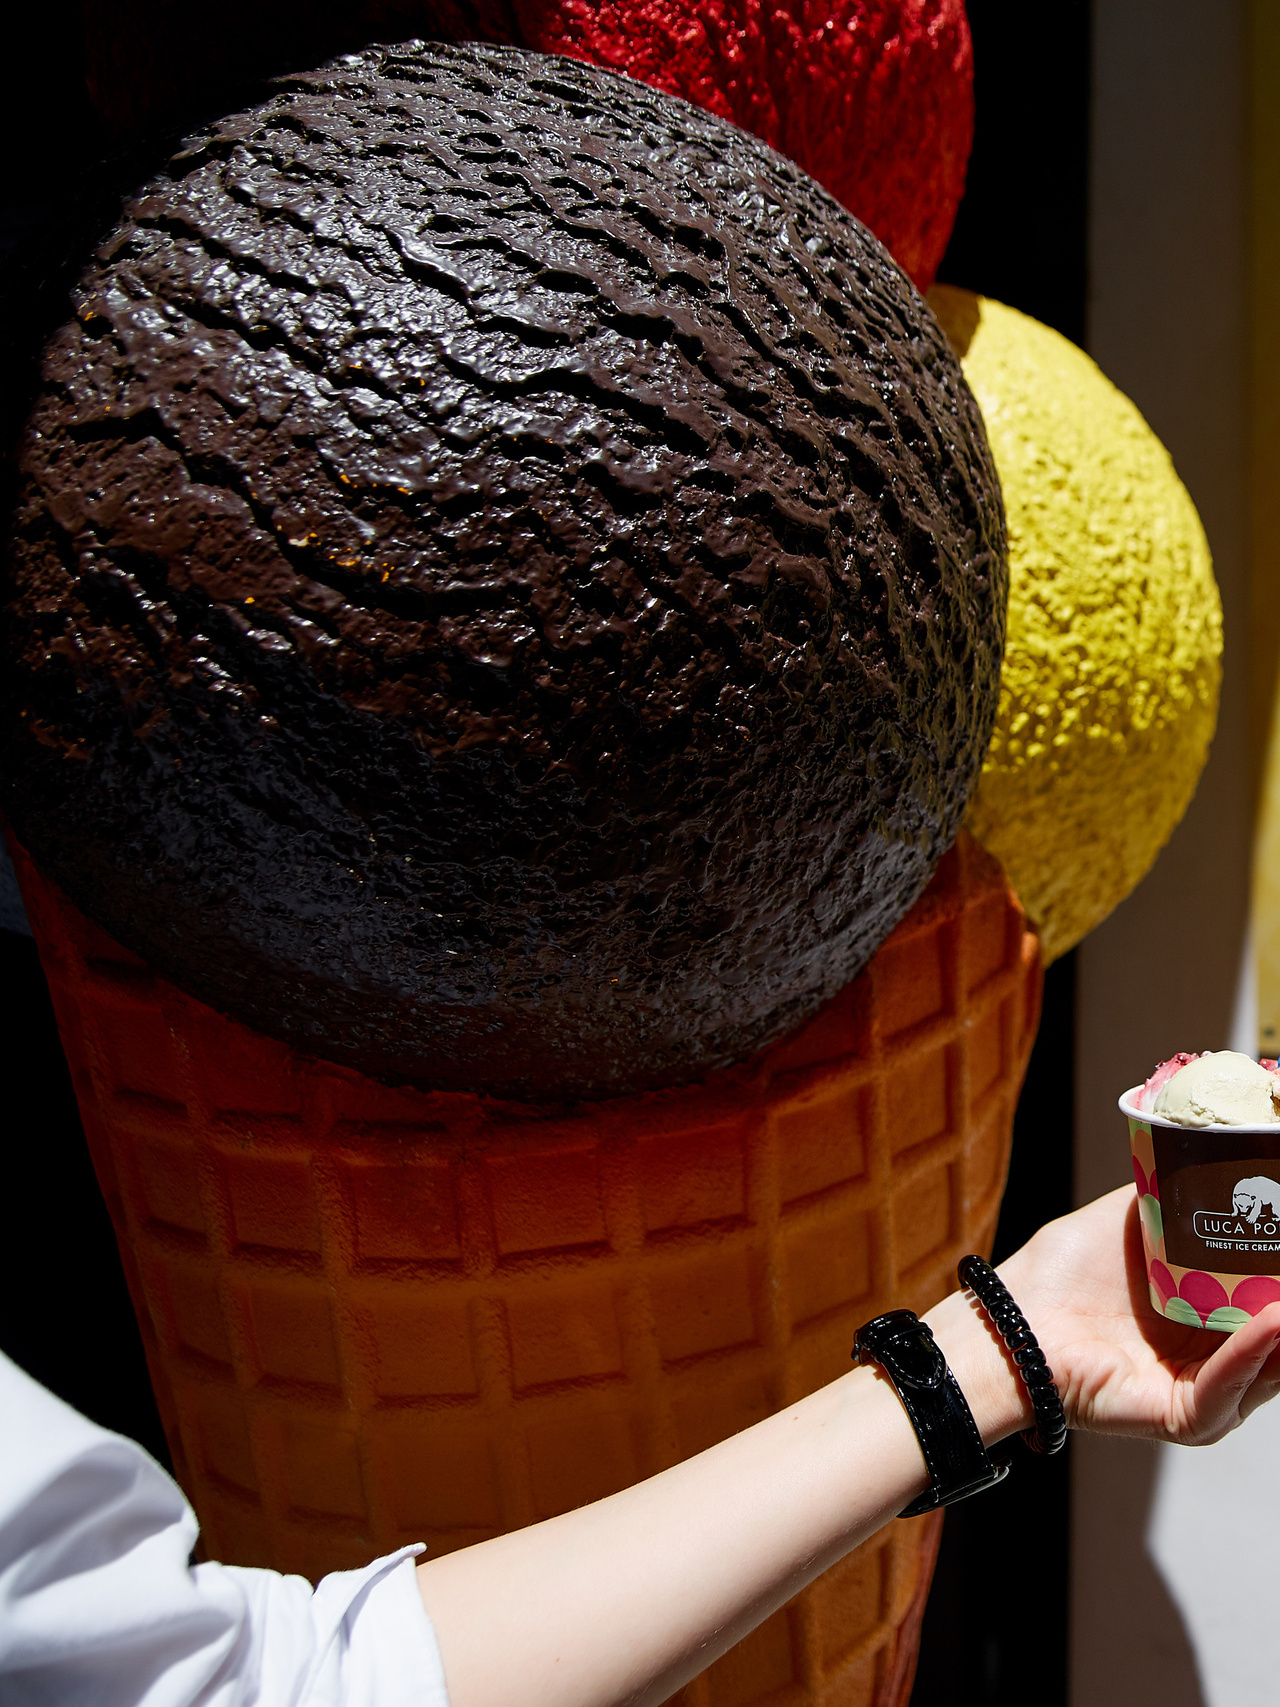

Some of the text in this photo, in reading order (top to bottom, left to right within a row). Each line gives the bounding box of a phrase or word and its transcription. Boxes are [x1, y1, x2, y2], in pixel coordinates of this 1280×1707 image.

[1204, 1219, 1245, 1235] LUCA
[1205, 1240, 1233, 1250] FINEST
[1235, 1243, 1250, 1251] ICE
